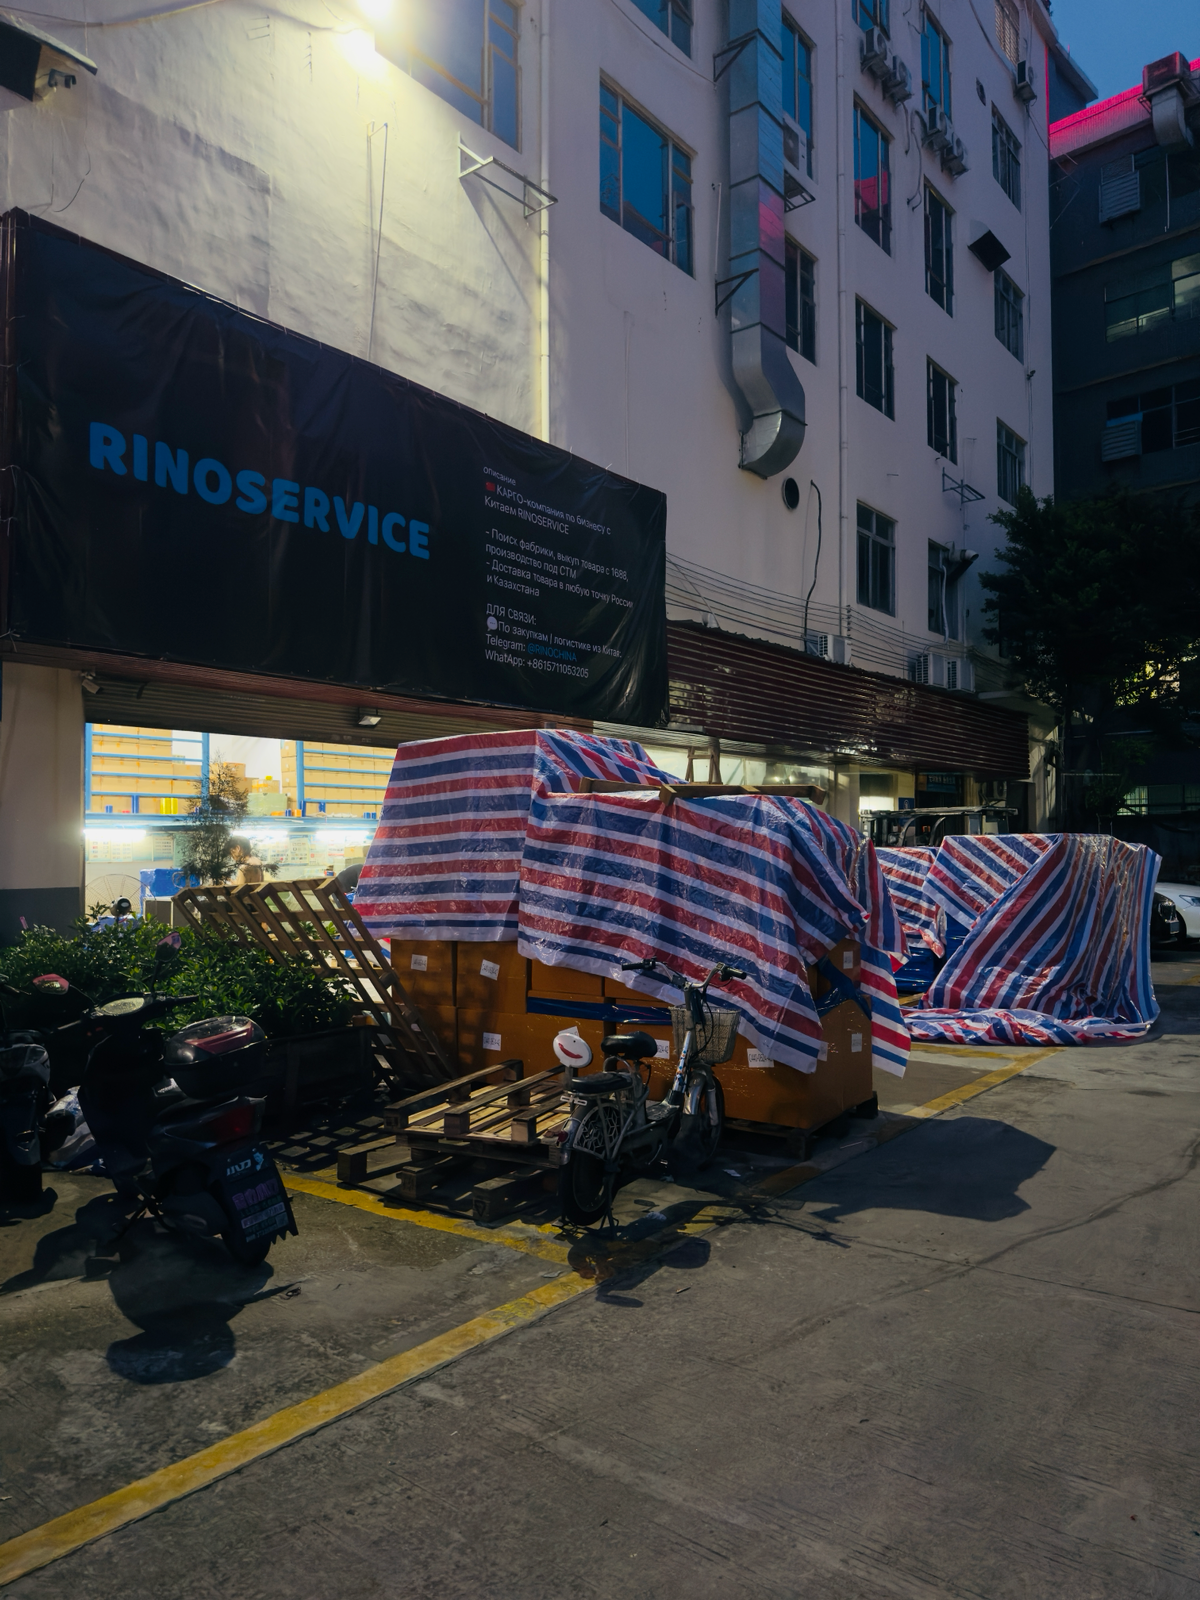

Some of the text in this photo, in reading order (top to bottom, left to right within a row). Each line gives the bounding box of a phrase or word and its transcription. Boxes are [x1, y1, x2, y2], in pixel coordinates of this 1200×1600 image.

[89, 421, 431, 560] RINOSERVICE
[483, 466, 516, 486] описание
[484, 496, 569, 534] Китаем RINOSERVICE
[496, 484, 611, 535] КАРГО-компания по бизнесу с
[486, 544, 576, 580] производство под СТМ
[492, 528, 518, 546] Поиск
[520, 539, 556, 560] фабрики,
[557, 552, 580, 566] выкуп
[580, 560, 604, 574] товара
[611, 568, 628, 582] 1688,
[486, 574, 540, 596] и Казахстана
[492, 559, 531, 580] Доставка
[533, 572, 558, 588] товара
[559, 582, 564, 590] в
[566, 584, 590, 596] любую
[591, 590, 610, 604] точку
[486, 603, 537, 625] ДЛЯ СВЯЗИ:
[486, 634, 578, 662] Telegram: @RINOCHINA
[498, 620, 510, 633] По
[512, 626, 548, 642] закупкам
[554, 636, 591, 651] логистике
[592, 645, 602, 654] из
[484, 649, 589, 678] WhatApp: +8615711053205
